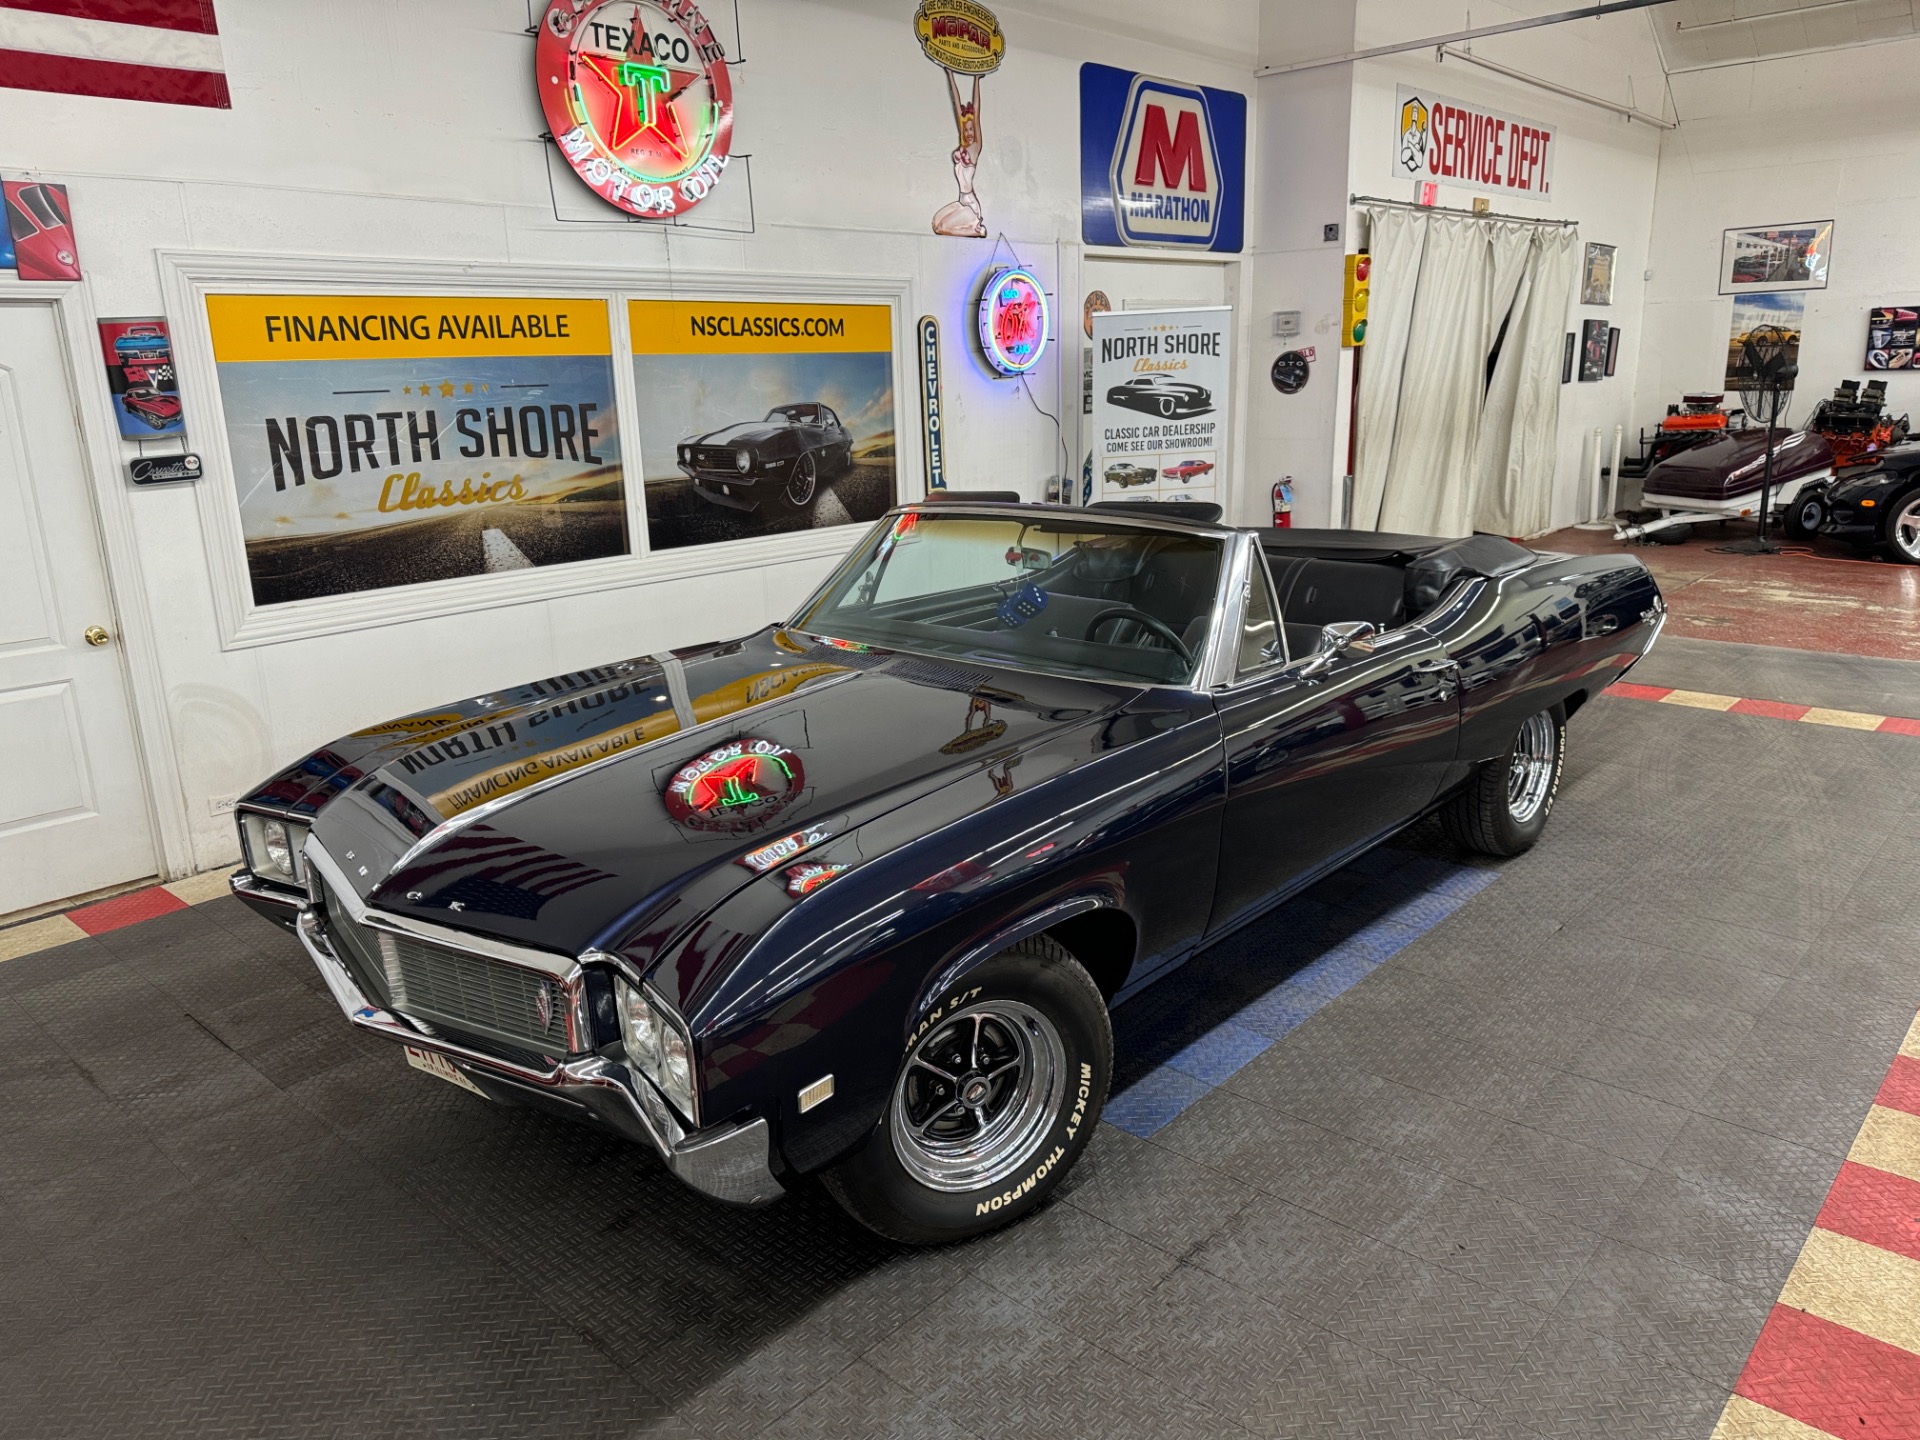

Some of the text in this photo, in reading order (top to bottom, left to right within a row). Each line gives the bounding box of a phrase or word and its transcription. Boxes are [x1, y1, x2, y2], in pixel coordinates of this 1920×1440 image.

[589, 21, 690, 64] TEXACO
[931, 16, 991, 52] MOPAR
[939, 39, 951, 47] PARTS
[1429, 102, 1551, 194] SERVICE DEPT.
[558, 126, 729, 214] MOTOR OIL
[1129, 191, 1210, 223] MARATHON
[264, 314, 570, 343] FINANCING AVAILABLE
[690, 315, 845, 337] NSCLASSICS.COM
[1101, 332, 1221, 364] NORTH SHORE
[1132, 357, 1189, 373] Classics
[925, 326, 942, 485] CHEVROLET
[264, 402, 603, 492] NORTH SHORE
[1104, 422, 1216, 440] CLASSIC CAR DEALERSHIP
[1106, 437, 1213, 453] COME SEE OUR SHOWROOM!
[132, 461, 188, 481] Corvette
[376, 471, 529, 514] Classics
[949, 986, 983, 1010] S/T
[975, 1062, 1092, 1217] MICKEY THOMPSON
